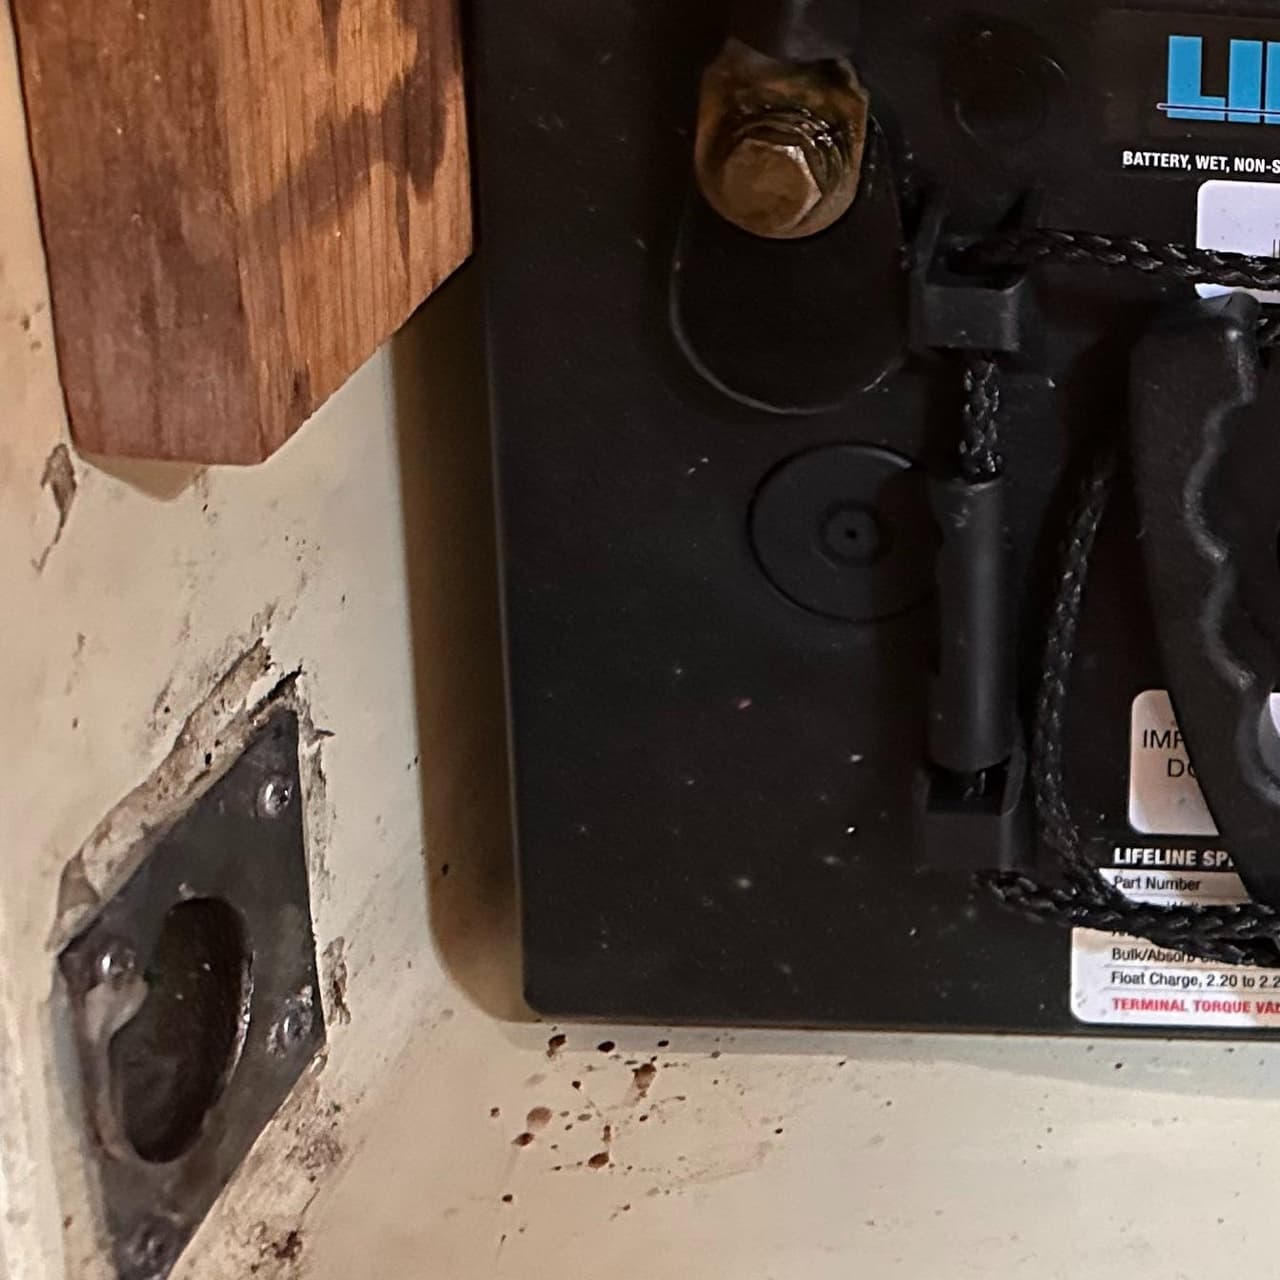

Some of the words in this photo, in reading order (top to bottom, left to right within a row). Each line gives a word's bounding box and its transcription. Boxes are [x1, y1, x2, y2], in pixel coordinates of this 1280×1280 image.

[1122, 150, 1192, 171] BATTERY,
[1195, 154, 1231, 173] WET,
[1113, 847, 1196, 867] LIFELINE
[1113, 875, 1142, 889] Part
[1146, 875, 1201, 891] Number
[1110, 970, 1144, 984] Float
[1149, 971, 1202, 988] Charge,
[1206, 972, 1238, 987] 2.20
[1242, 974, 1255, 987] to
[1112, 996, 1187, 1012] TERMINAL
[1193, 999, 1251, 1013] TORQUE
